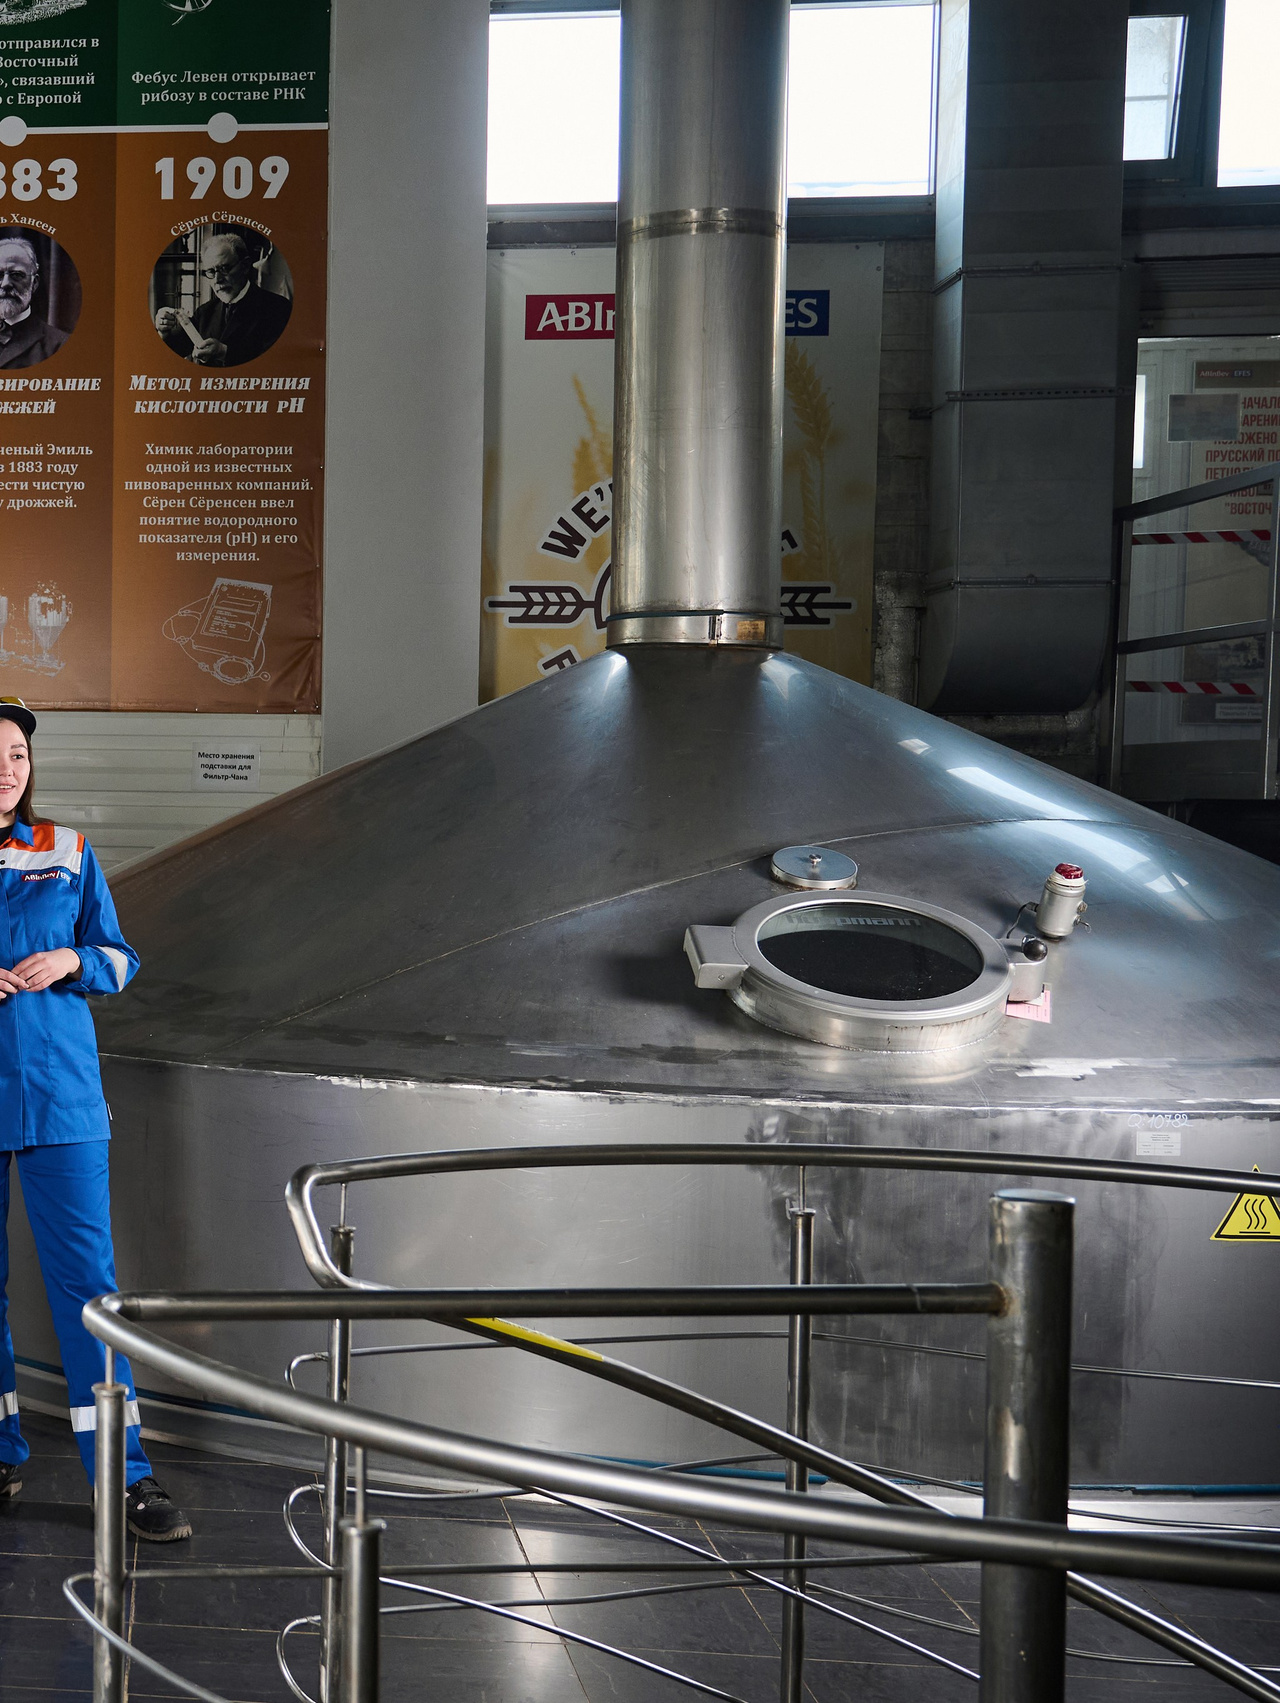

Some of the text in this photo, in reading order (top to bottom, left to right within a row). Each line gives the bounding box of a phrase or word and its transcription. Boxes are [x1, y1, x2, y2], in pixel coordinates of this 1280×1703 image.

[91, 38, 99, 47] в
[12, 72, 95, 86] связавший
[132, 71, 316, 86] Фебус Левен открывает
[7, 96, 14, 105] с
[18, 91, 81, 107] Европой
[141, 87, 306, 105] рибозу в составе РНК
[155, 156, 290, 200] 1909
[10, 213, 57, 235] Хансен
[170, 211, 272, 236] Сёрен Сёренсен
[1241, 396, 1280, 410] НАЧАЛ
[47, 444, 93, 455] Эмиль
[145, 443, 293, 458] Химик лаборатории
[1206, 447, 1265, 462] ПРУССКИЙ
[124, 479, 313, 493] пивоваренных компаний.
[7, 496, 77, 511] дрожжей.
[1225, 502, 1272, 515] "ВОСТОЧ
[176, 552, 259, 564] измерения.
[202, 773, 248, 781] Фильтр-Чана
